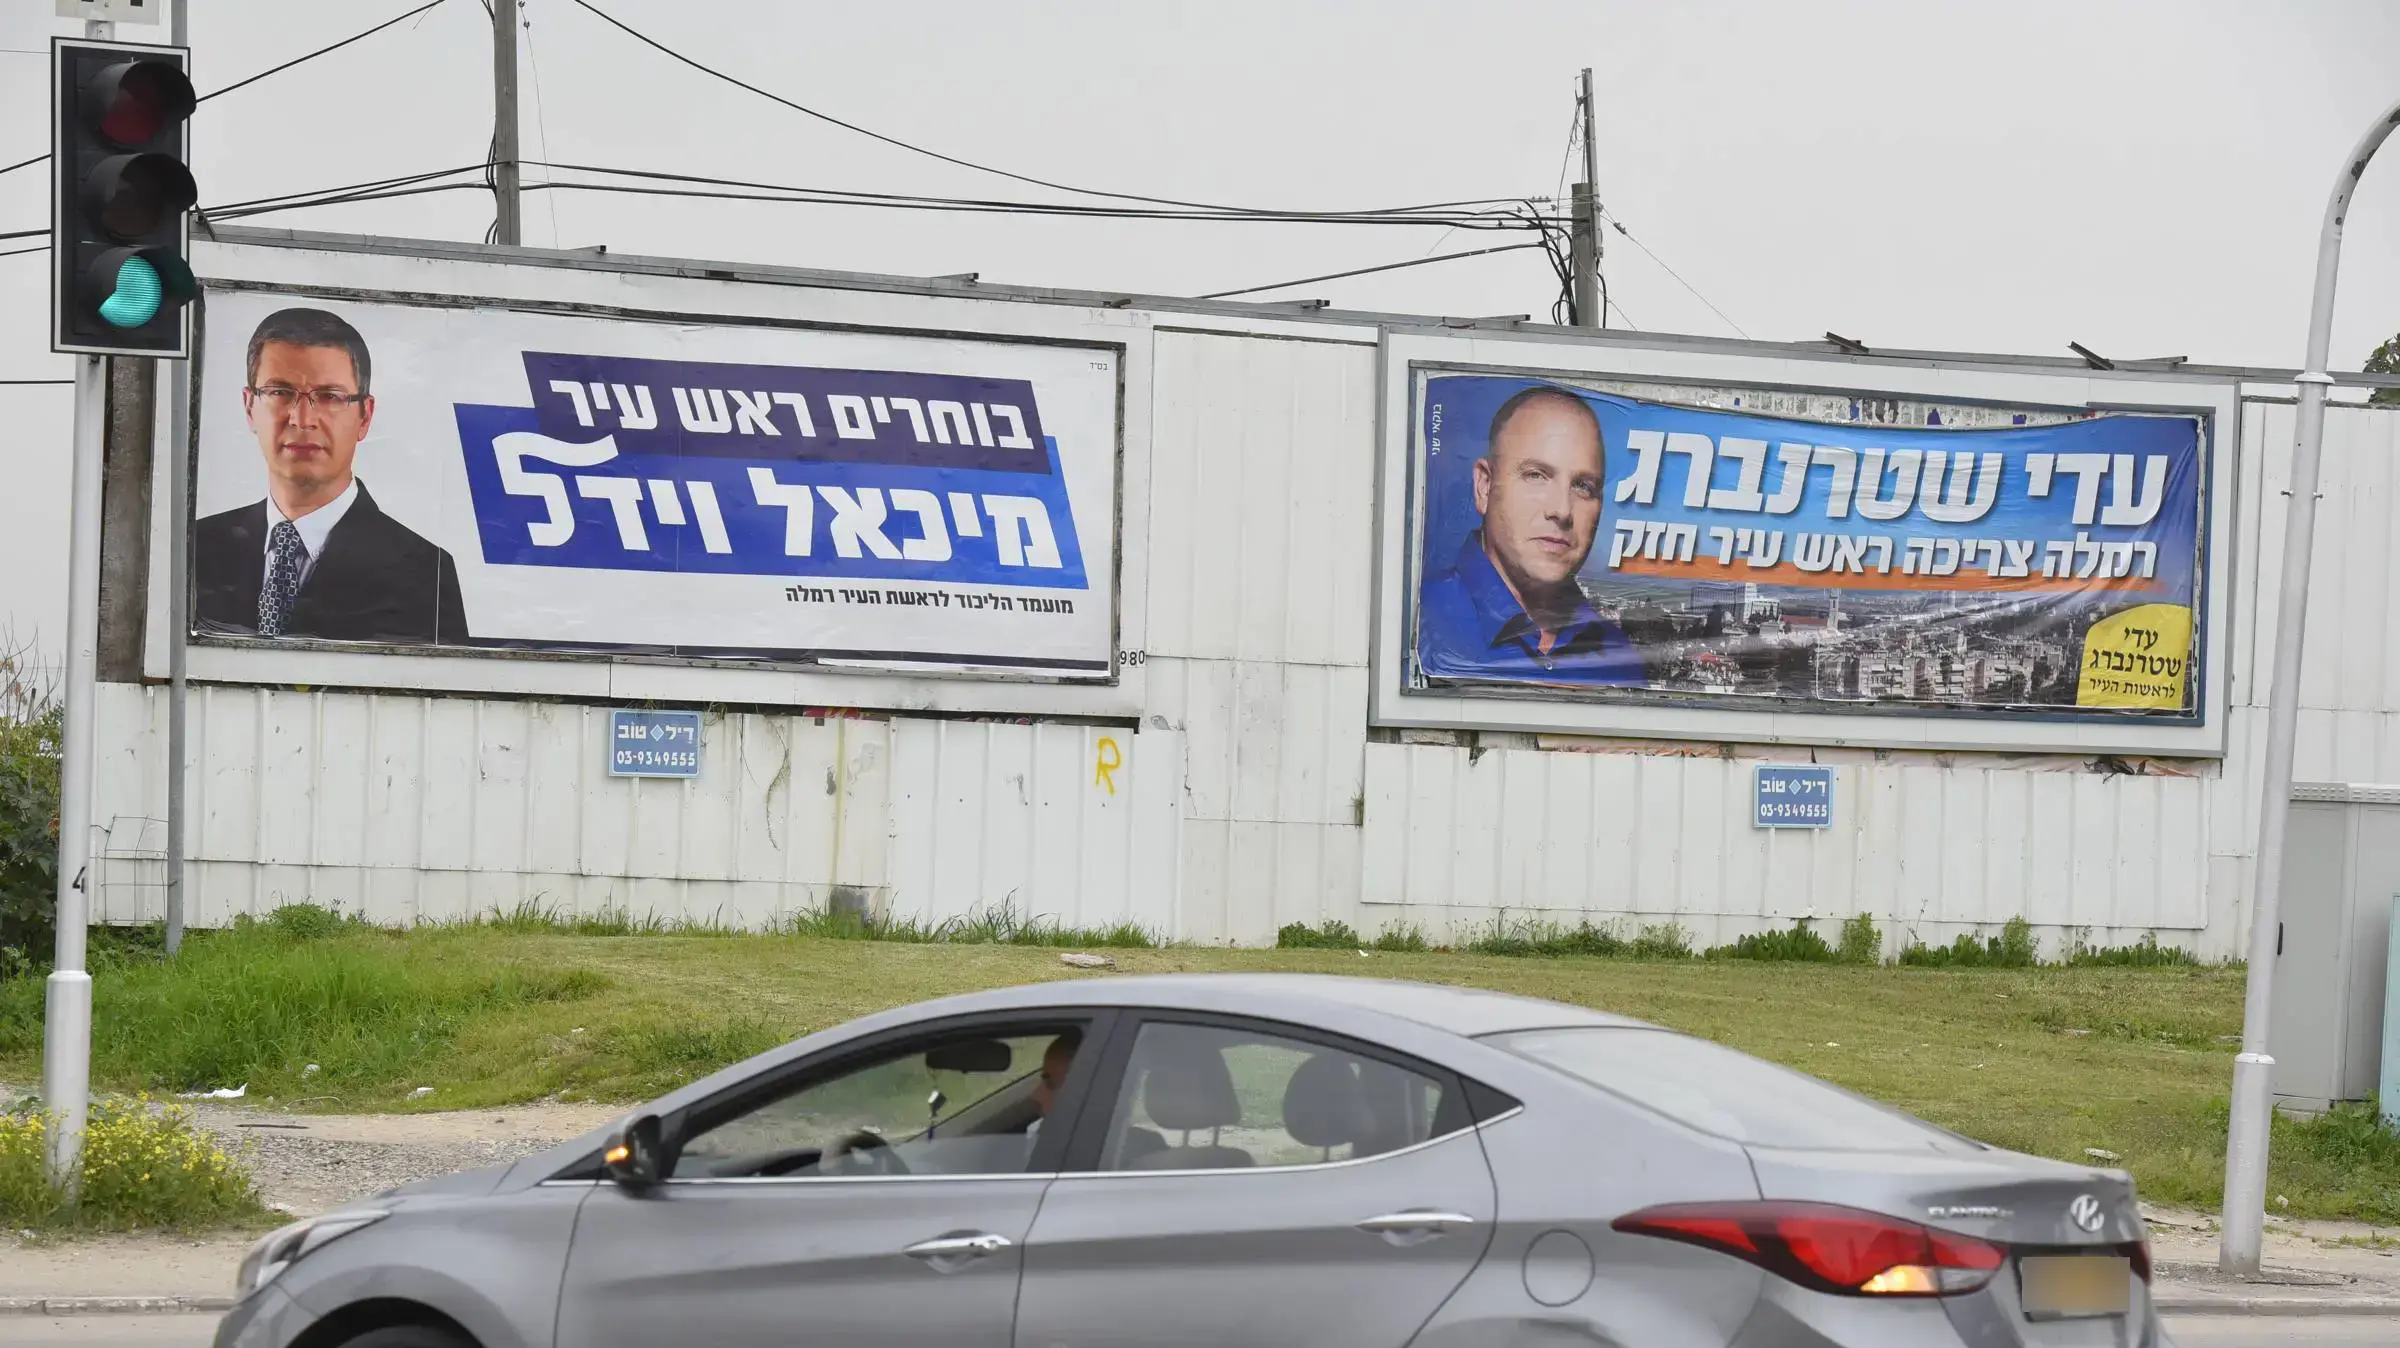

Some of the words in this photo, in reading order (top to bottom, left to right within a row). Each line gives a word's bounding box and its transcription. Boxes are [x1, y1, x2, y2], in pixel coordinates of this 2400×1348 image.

[549, 379, 658, 430] עיר
[671, 387, 817, 437] ראש
[827, 394, 1035, 450] בוחרים
[491, 432, 733, 555] וידל
[1614, 429, 2002, 523] שטרנברג
[2024, 453, 2168, 526] עדי
[746, 466, 1063, 569] מיכאל
[1608, 518, 1698, 568] חזק
[1709, 526, 1783, 568] עיר
[1793, 532, 1893, 574] ראש
[1902, 537, 2034, 578] צריכה
[2041, 532, 2157, 579] רמלה
[785, 584, 835, 603] רמלה
[838, 587, 881, 606] העיר
[954, 592, 1013, 611] הליכוד
[1016, 596, 1074, 615] מועמד
[1120, 649, 1145, 666] 980
[2123, 626, 2159, 651] עדי
[2089, 648, 2181, 677] שטרנברג
[2089, 677, 2119, 693] העיר
[2122, 682, 2176, 699] לראשות
[616, 750, 696, 767] 03-9349555
[1095, 736, 1121, 797] R
[1760, 803, 1828, 818] 03-9349555
[72, 865, 86, 894] 4
